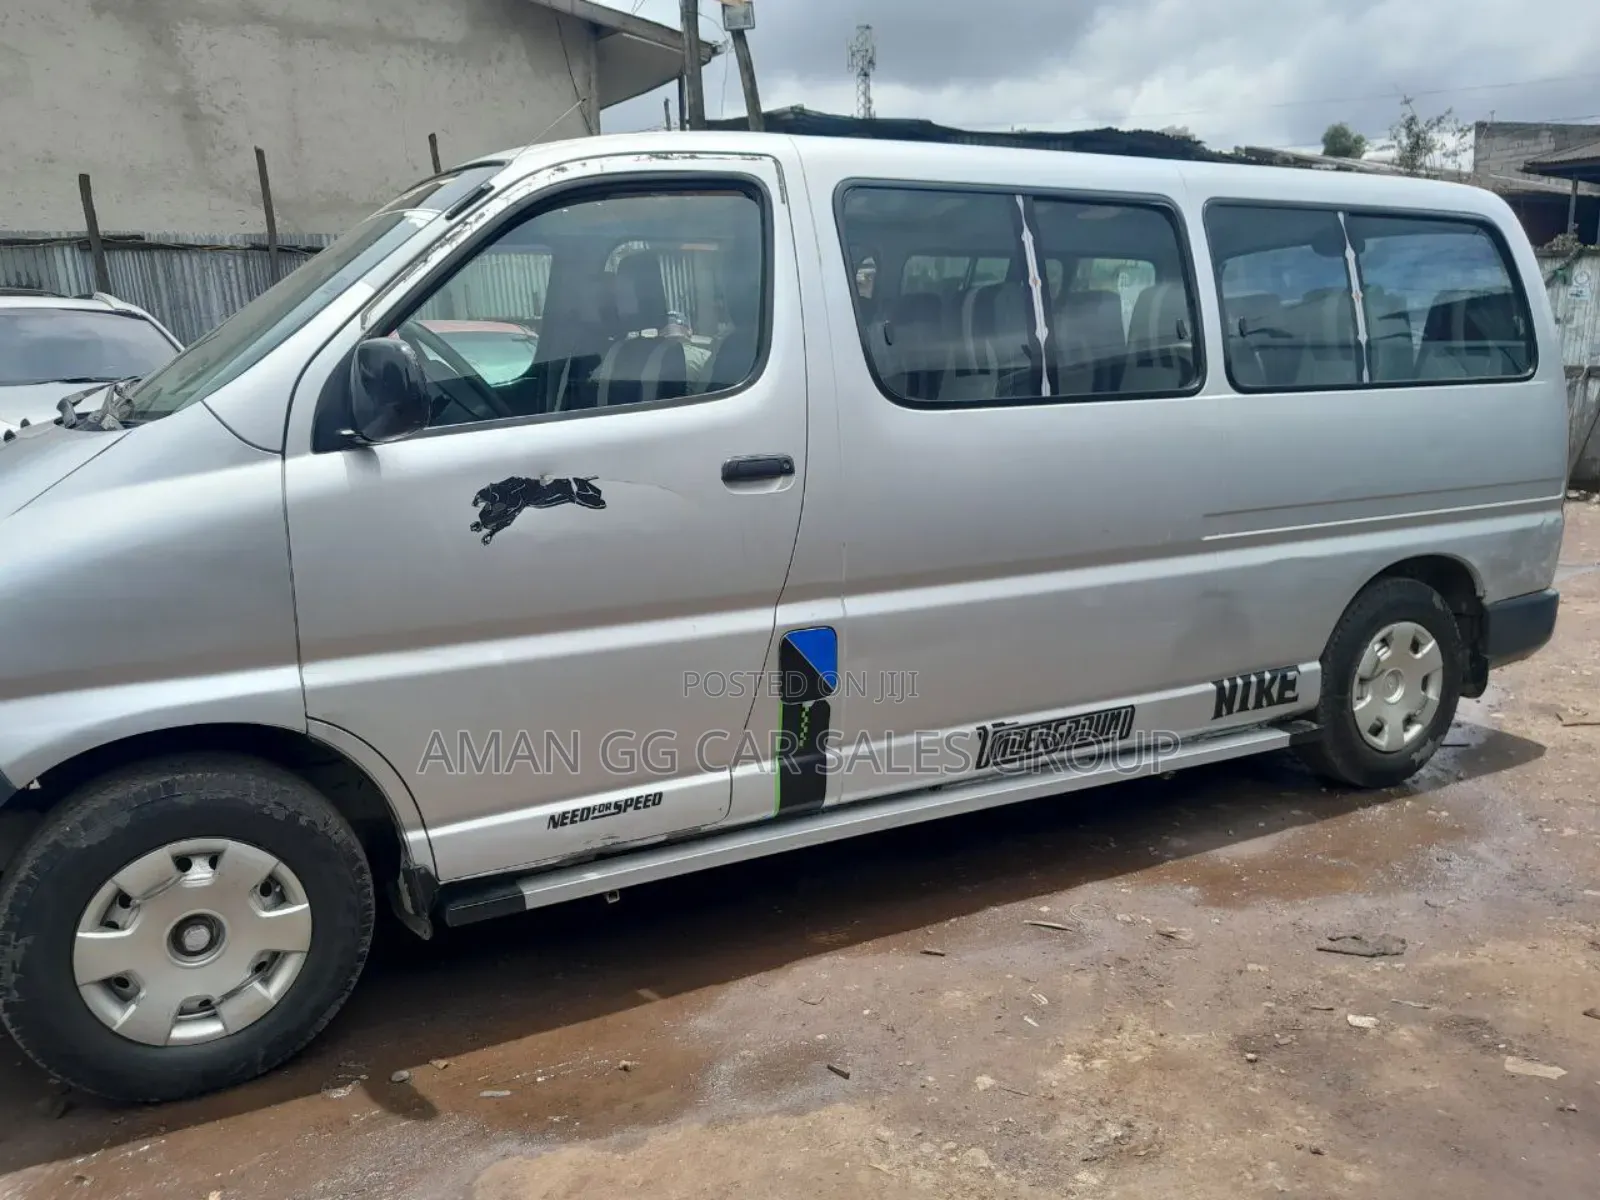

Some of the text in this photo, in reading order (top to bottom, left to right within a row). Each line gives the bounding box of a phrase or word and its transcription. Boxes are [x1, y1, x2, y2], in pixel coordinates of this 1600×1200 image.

[1210, 665, 1300, 720] NIKE
[547, 791, 663, 830] NEED FOR SPEED
